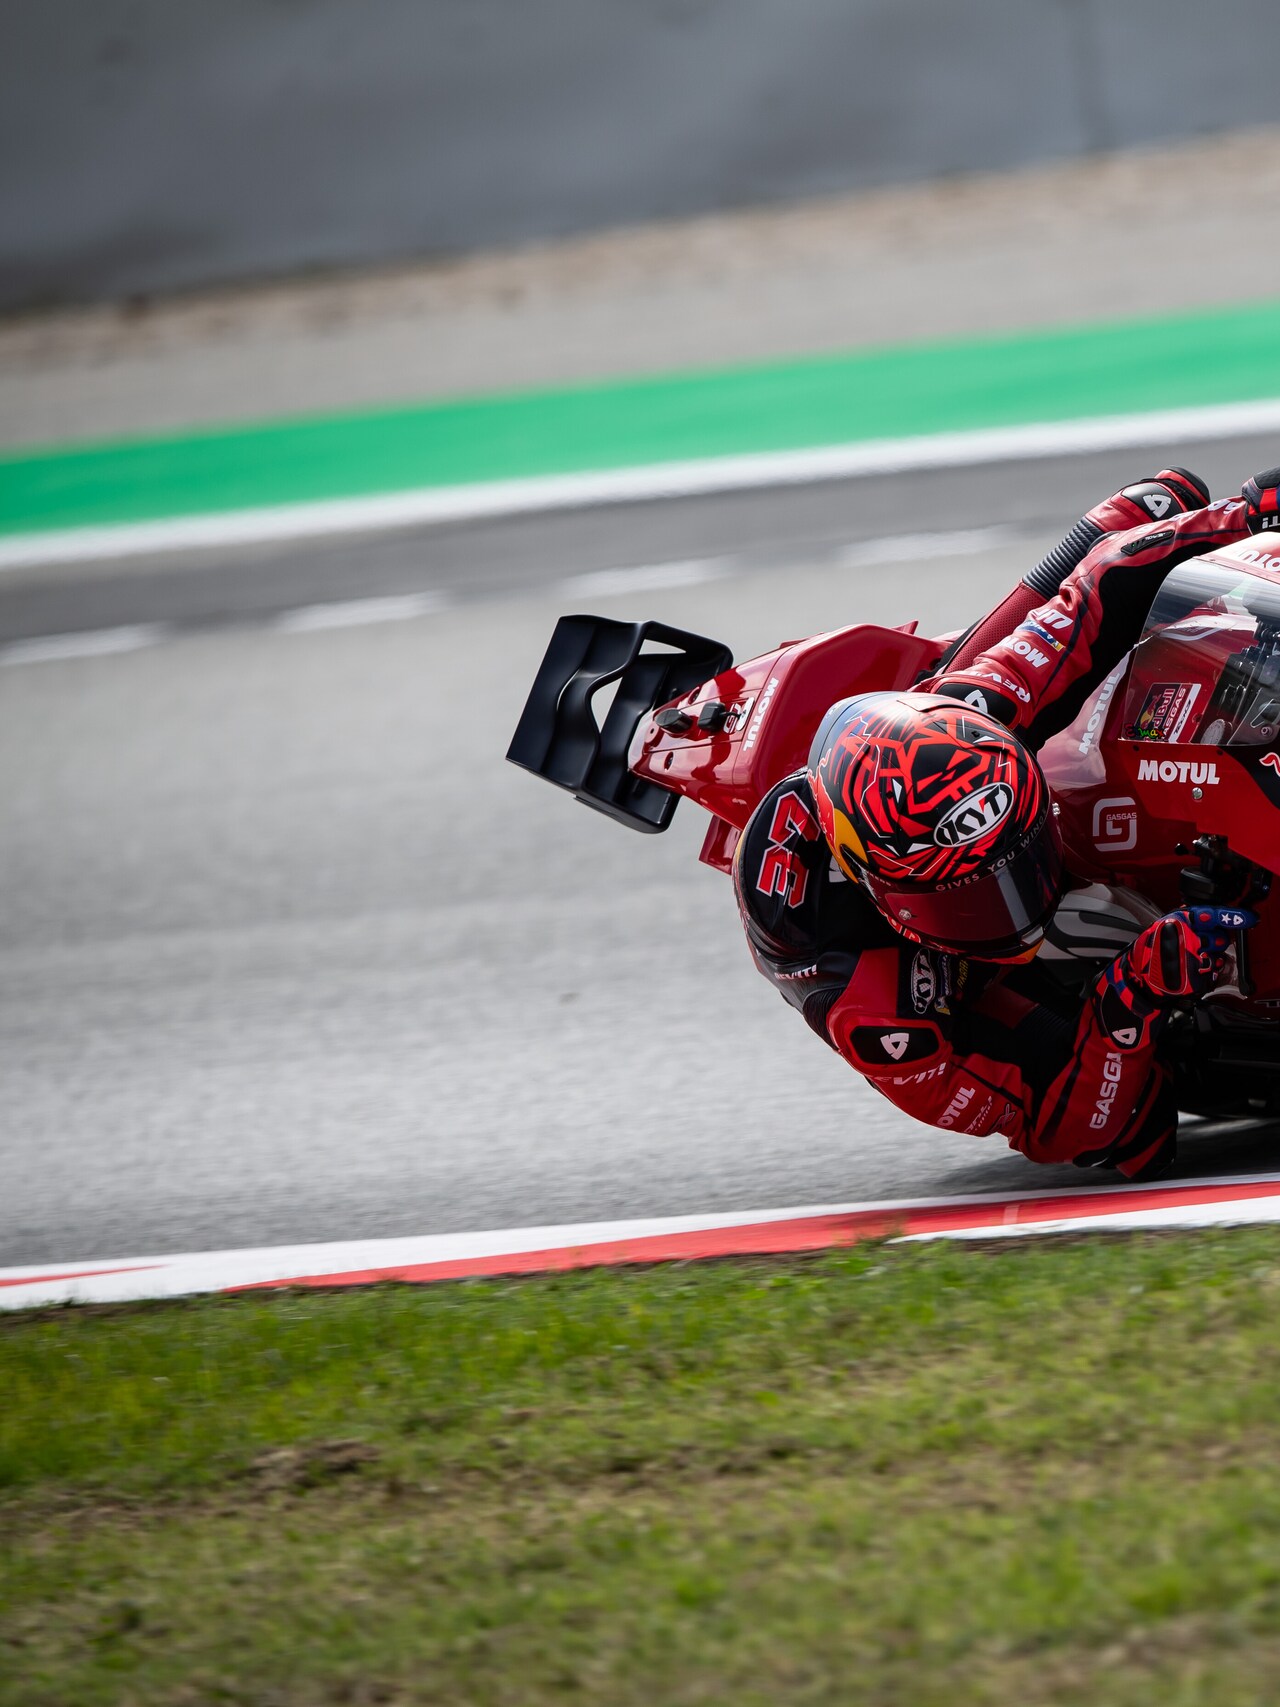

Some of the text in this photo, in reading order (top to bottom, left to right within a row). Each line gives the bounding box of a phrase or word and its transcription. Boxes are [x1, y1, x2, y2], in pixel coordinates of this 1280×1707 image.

[742, 677, 779, 752] MOTUL
[1078, 672, 1121, 755] MOTUL
[1162, 687, 1186, 736] ASGAS
[1137, 759, 1221, 785] MOTUL
[942, 784, 1003, 847] KYT
[1106, 812, 1137, 821] GASGAS
[756, 790, 821, 909] 37
[935, 873, 981, 892] GIVES
[987, 850, 1016, 872] YOU
[871, 1062, 947, 1085] EV'IT!
[1089, 1052, 1123, 1130] GASGA
[936, 1086, 977, 1127] OTUL
